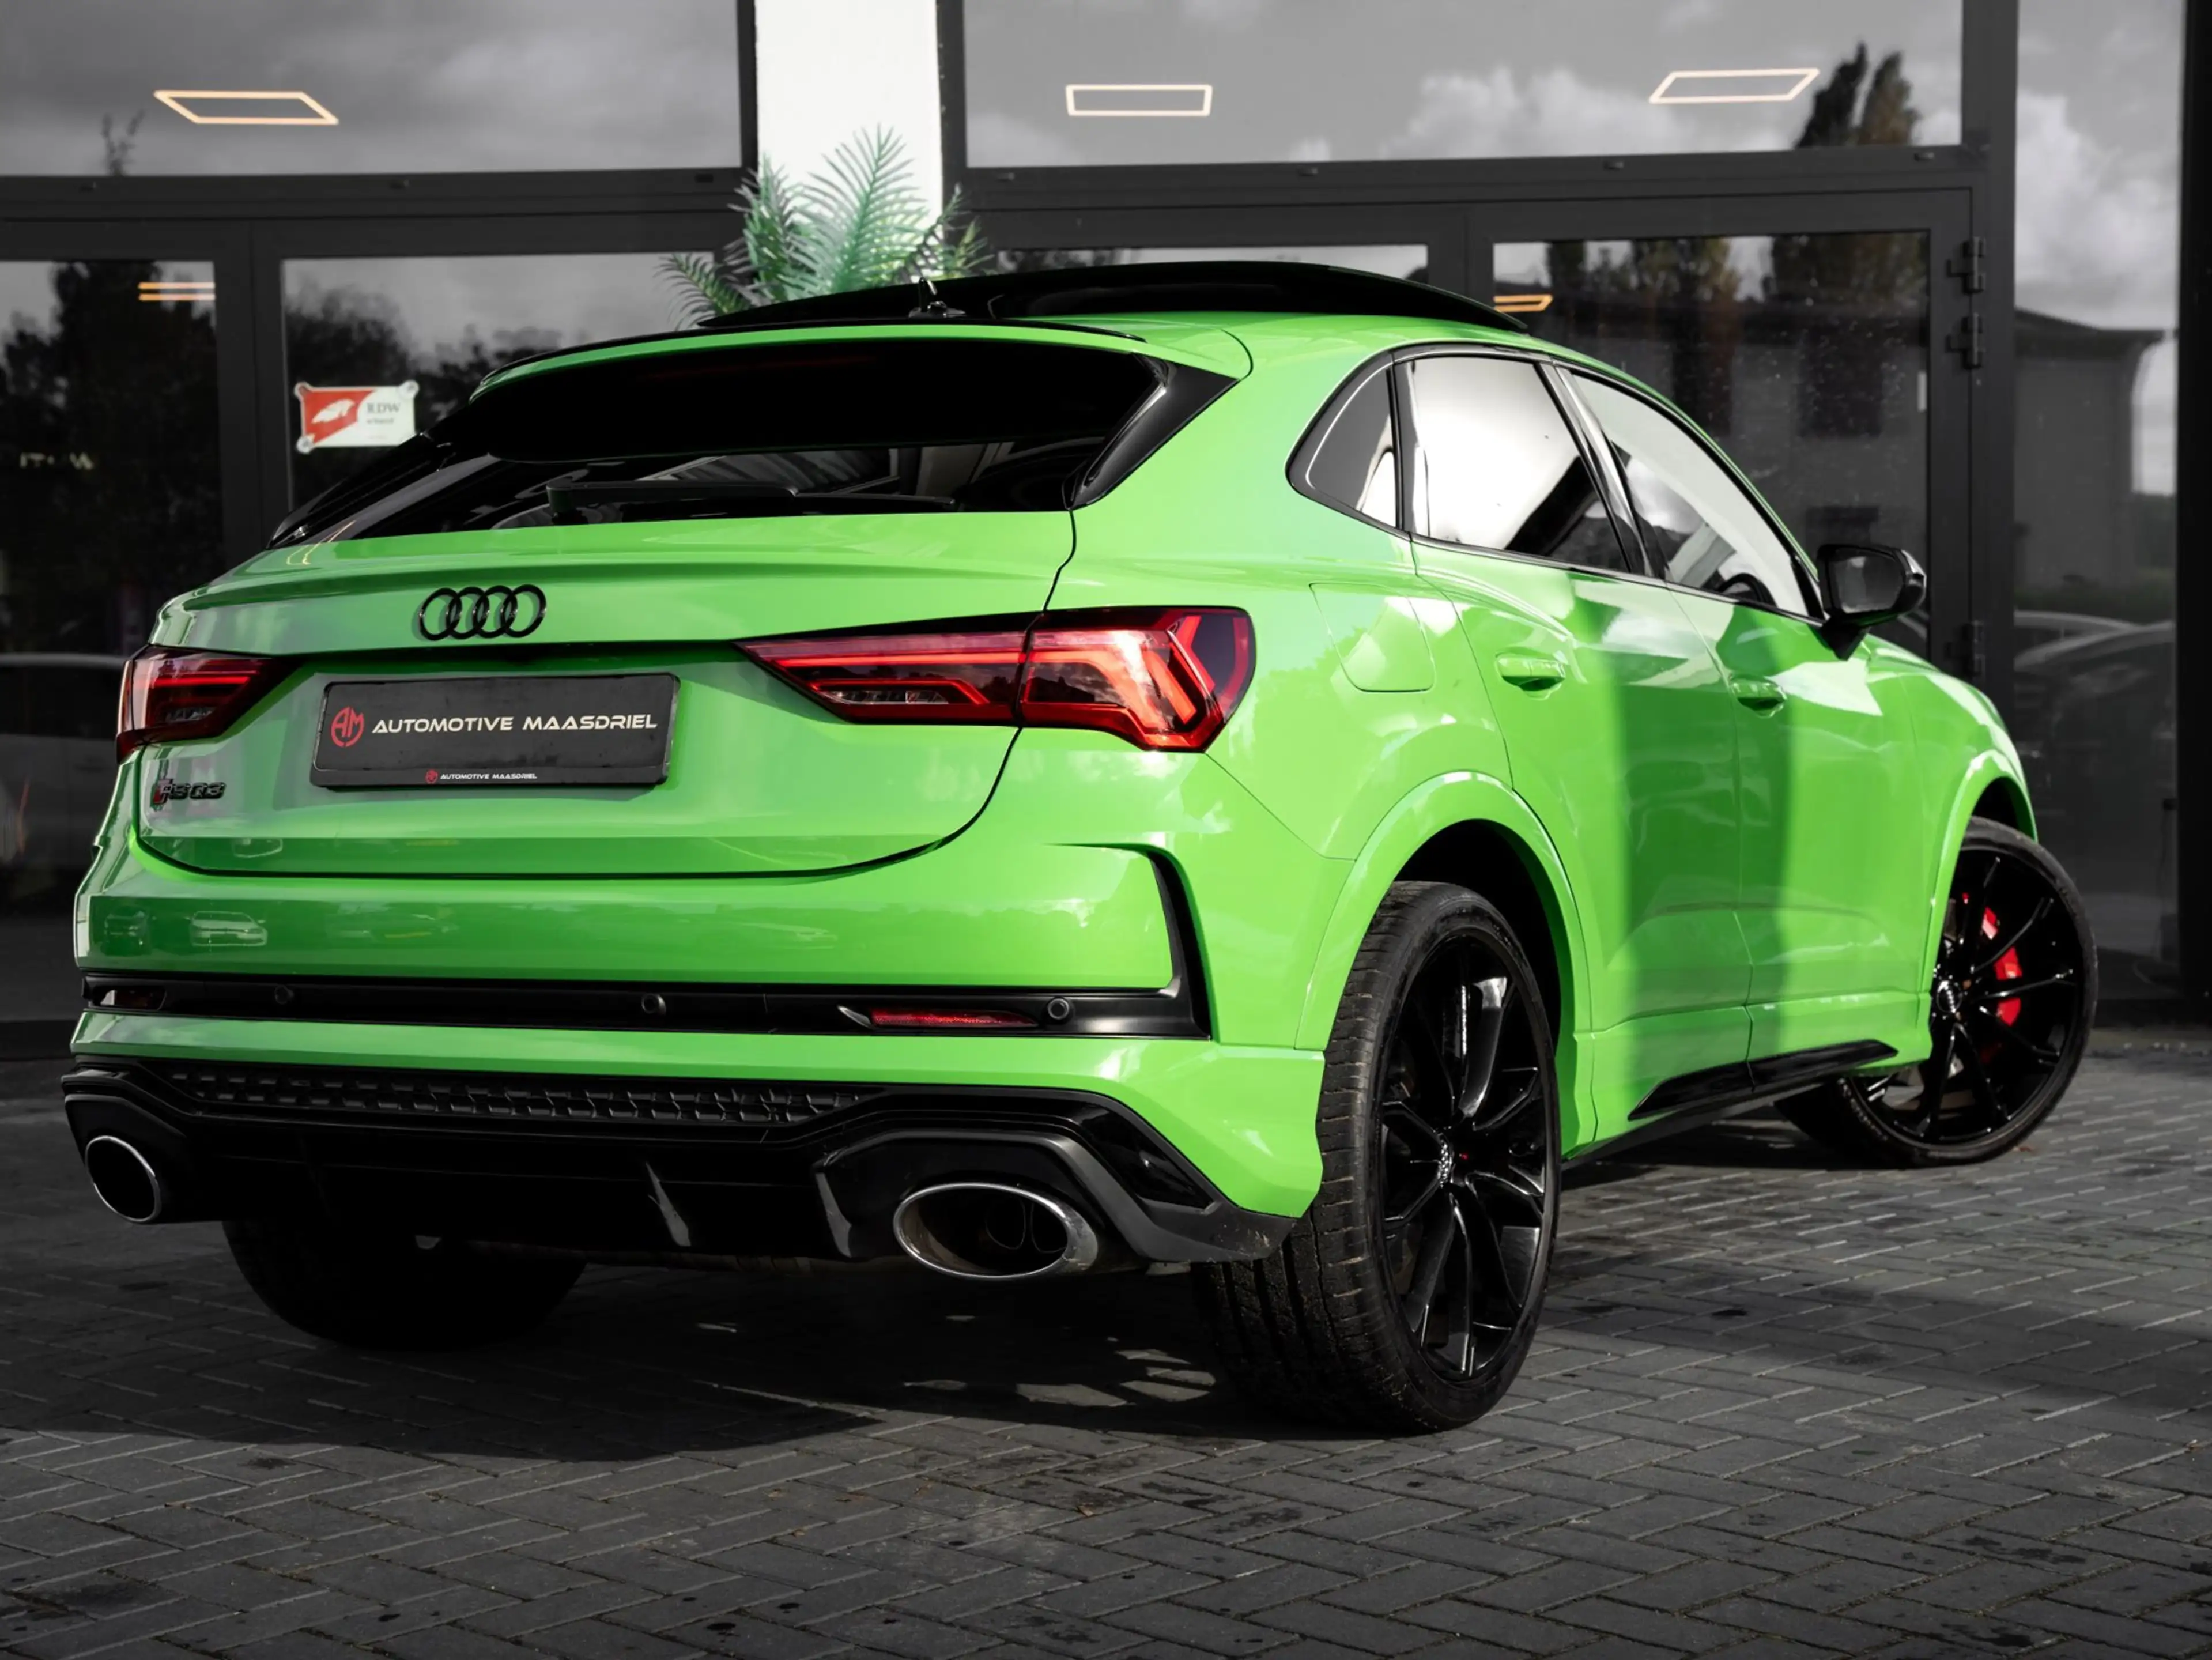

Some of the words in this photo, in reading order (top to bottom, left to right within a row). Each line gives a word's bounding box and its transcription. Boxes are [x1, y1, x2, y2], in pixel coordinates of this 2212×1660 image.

[367, 402, 401, 413] RDW
[372, 716, 514, 734] AUTOMOTIVE
[522, 714, 658, 730] MAASDRIEL
